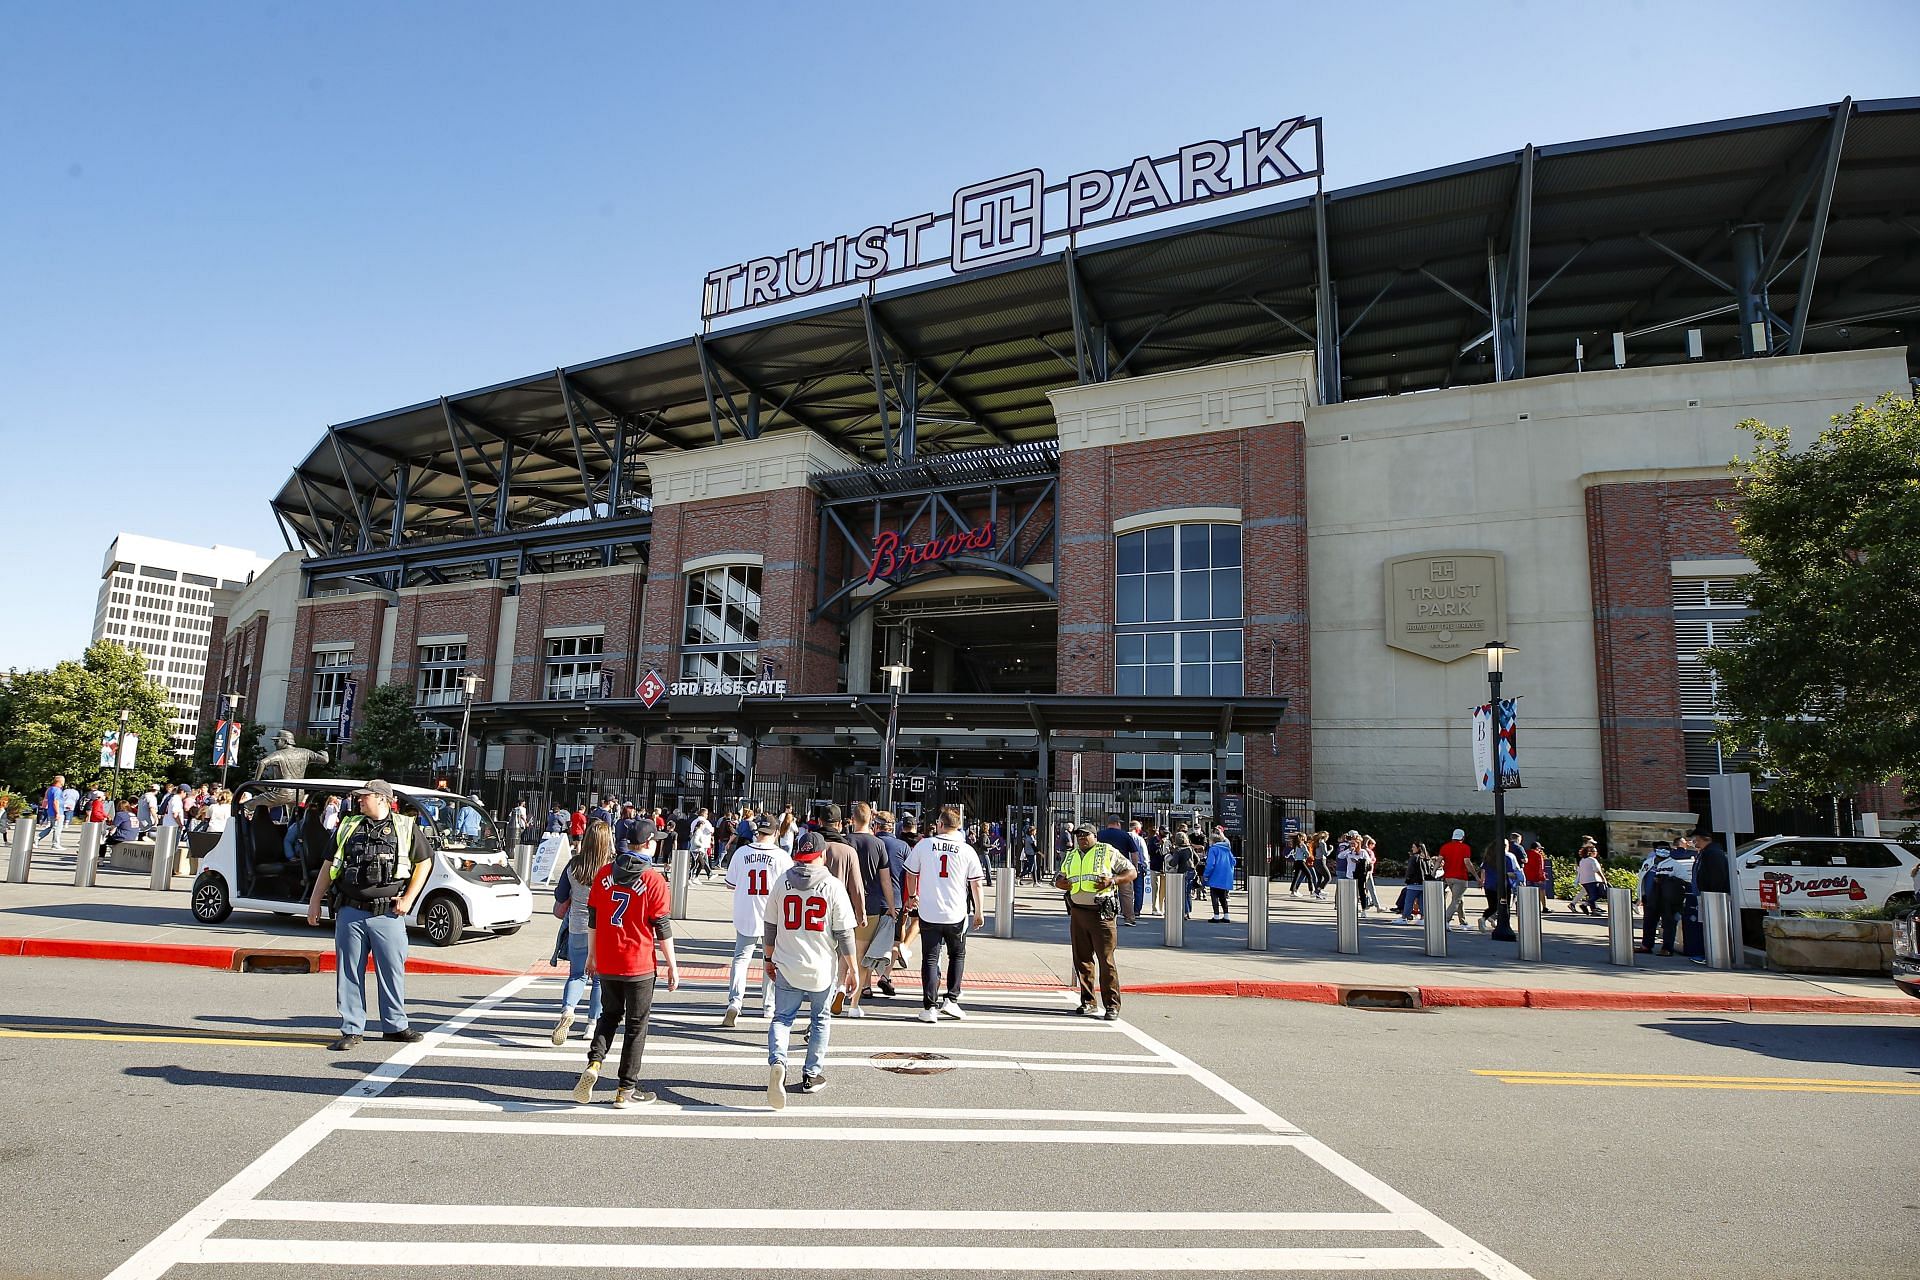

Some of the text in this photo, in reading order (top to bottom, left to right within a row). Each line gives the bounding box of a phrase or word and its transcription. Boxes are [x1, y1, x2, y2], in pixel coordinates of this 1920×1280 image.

[708, 116, 1305, 313] TRUIST PARK
[866, 520, 995, 585] Braves
[1408, 584, 1481, 601] TRUIST
[1418, 602, 1472, 617] PARK
[670, 680, 787, 696] 3RD BASE GATE
[1501, 774, 1518, 786] PLAY
[932, 842, 960, 854] ALBIES
[744, 853, 775, 867] INCIARTE
[939, 854, 949, 878] 1
[748, 869, 769, 895] 11
[1779, 873, 1849, 895] Braves
[611, 890, 631, 928] 7
[783, 894, 827, 932] 02
